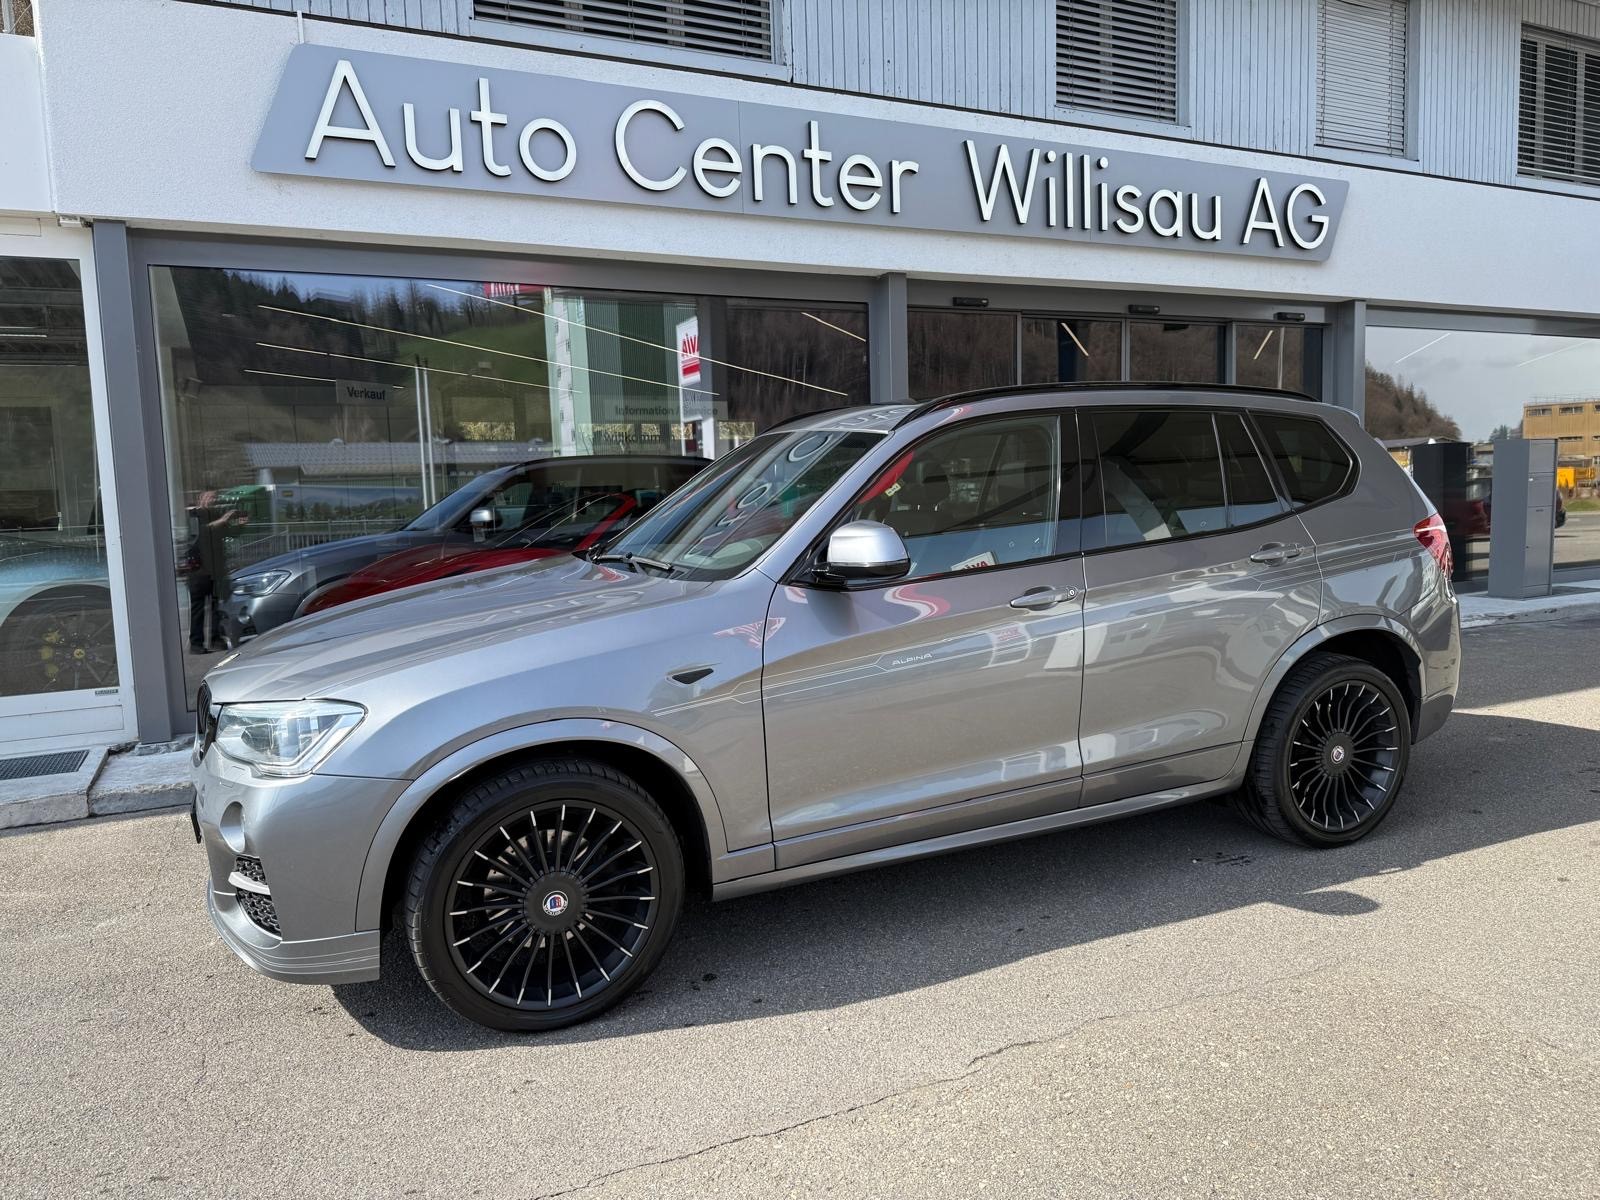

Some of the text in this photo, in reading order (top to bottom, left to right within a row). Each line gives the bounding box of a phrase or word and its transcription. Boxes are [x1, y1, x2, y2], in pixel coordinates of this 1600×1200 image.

[304, 59, 1330, 250] Auto Center Willisau AG
[346, 386, 386, 400] Verkauf
[615, 405, 674, 416] Information
[892, 653, 933, 666] ALPINA
